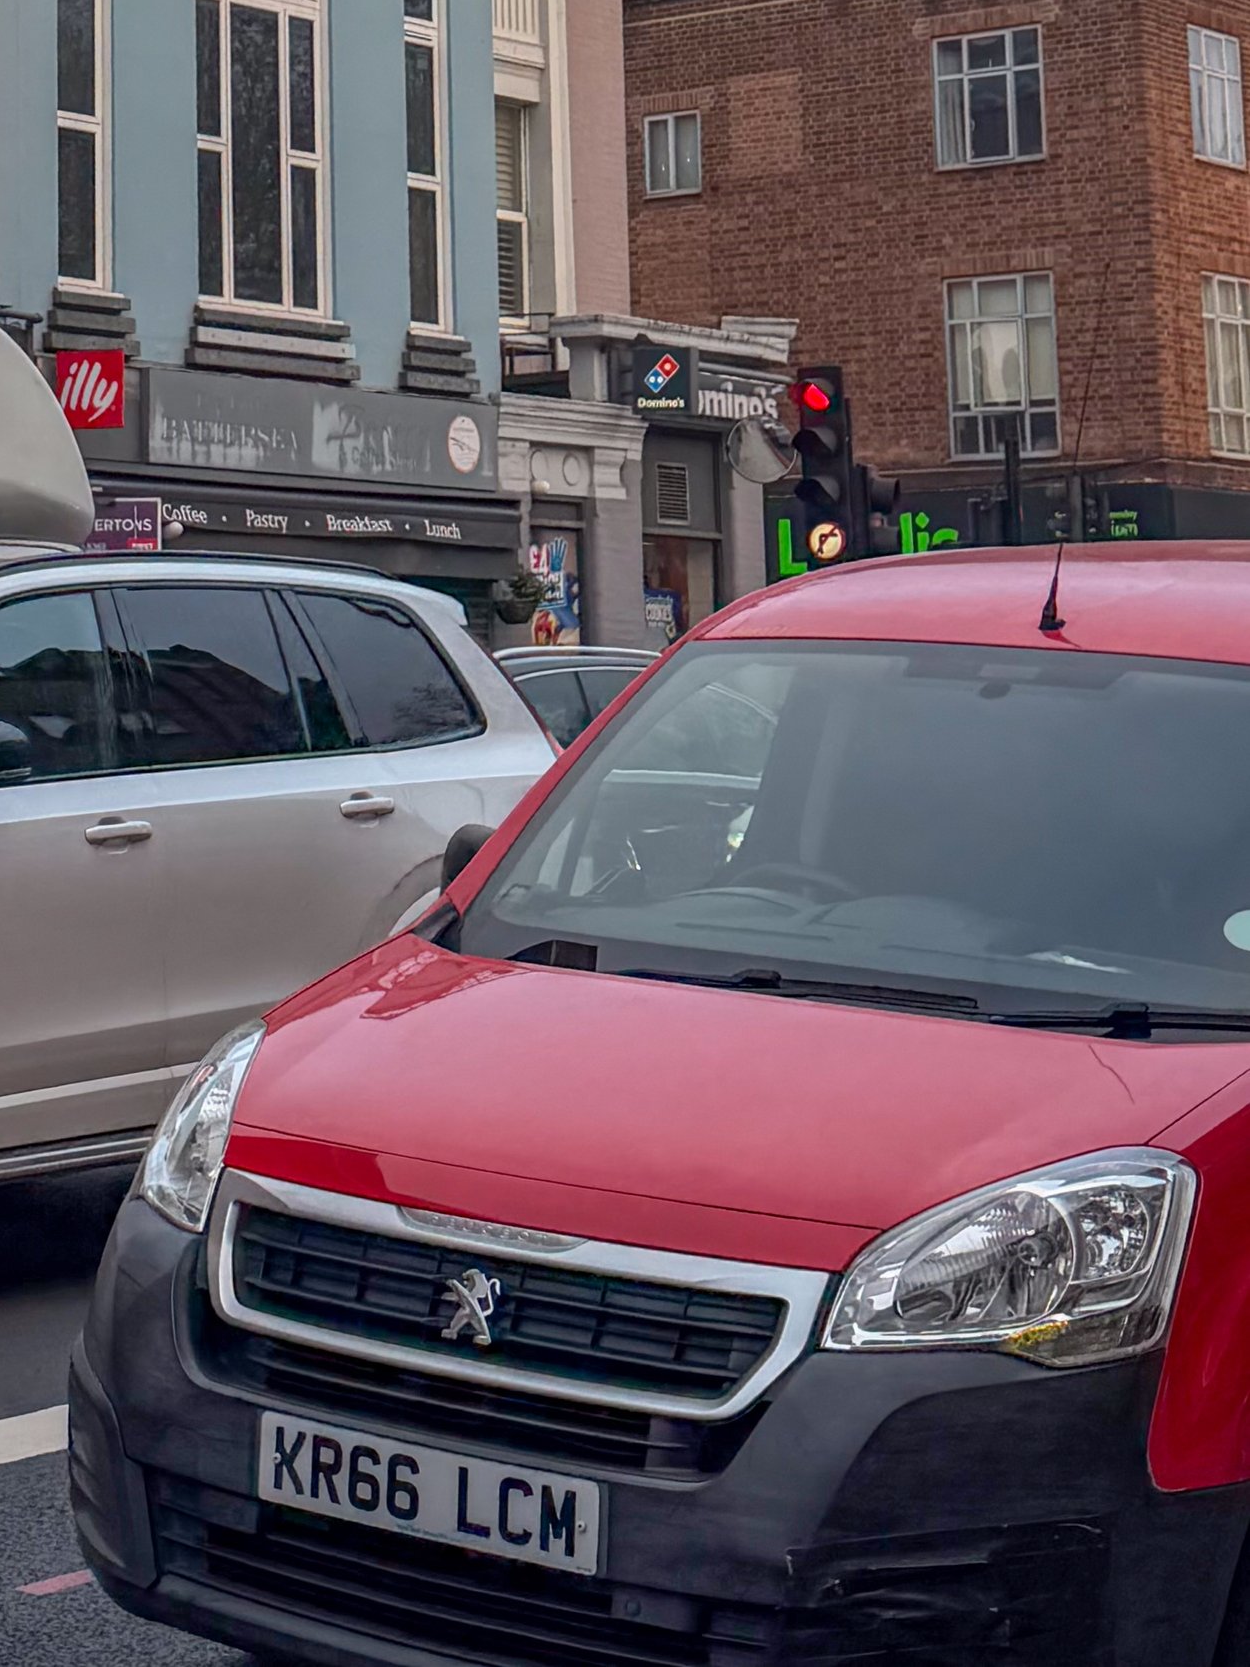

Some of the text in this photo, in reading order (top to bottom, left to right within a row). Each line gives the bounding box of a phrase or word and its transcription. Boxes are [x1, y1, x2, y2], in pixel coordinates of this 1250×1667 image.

[61, 359, 119, 423] illy
[637, 397, 685, 409] Domino's
[162, 504, 462, 540] Coffee Pastry Breakfast Lunch
[273, 1426, 577, 1558] KR66 LCM
